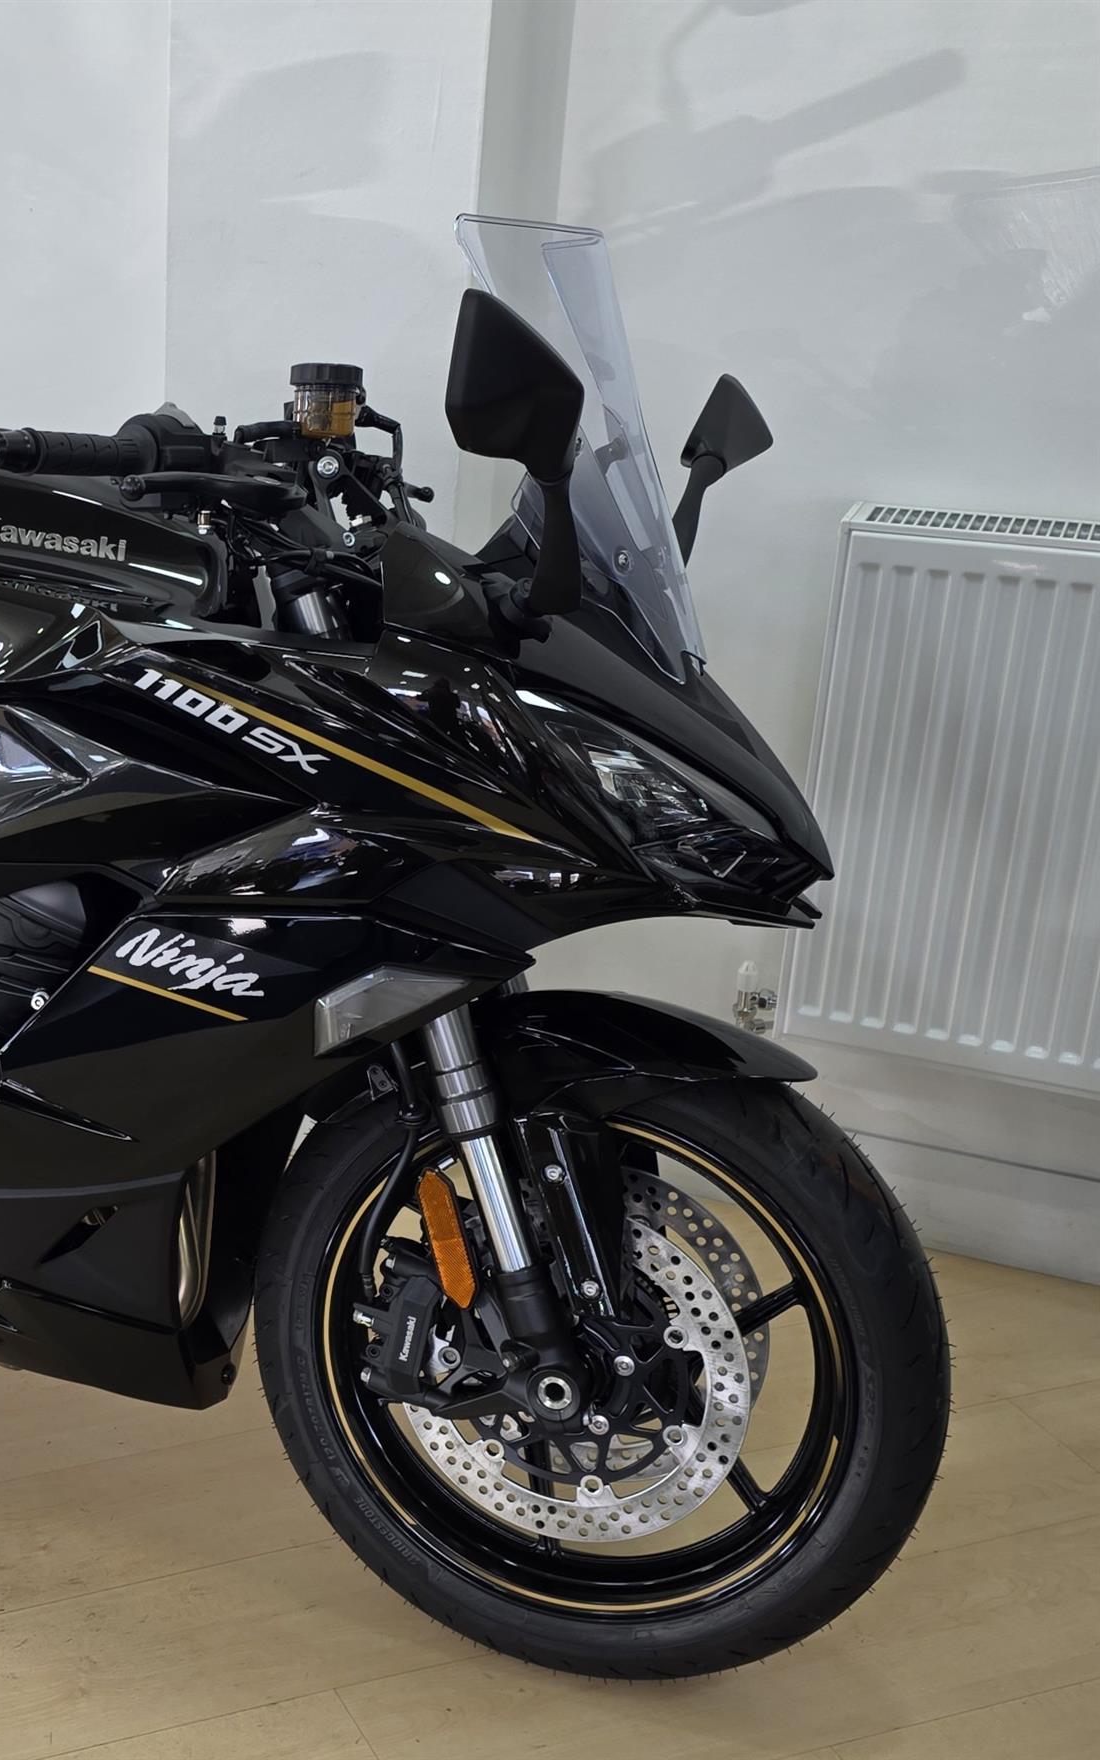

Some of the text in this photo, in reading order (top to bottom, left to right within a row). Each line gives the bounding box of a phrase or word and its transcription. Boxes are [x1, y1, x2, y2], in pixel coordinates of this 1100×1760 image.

[134, 668, 331, 775] 1100 SX
[115, 928, 265, 997] Ninja
[398, 1315, 417, 1362] Kawasaki
[353, 1494, 422, 1567] BRIDGESTONE
